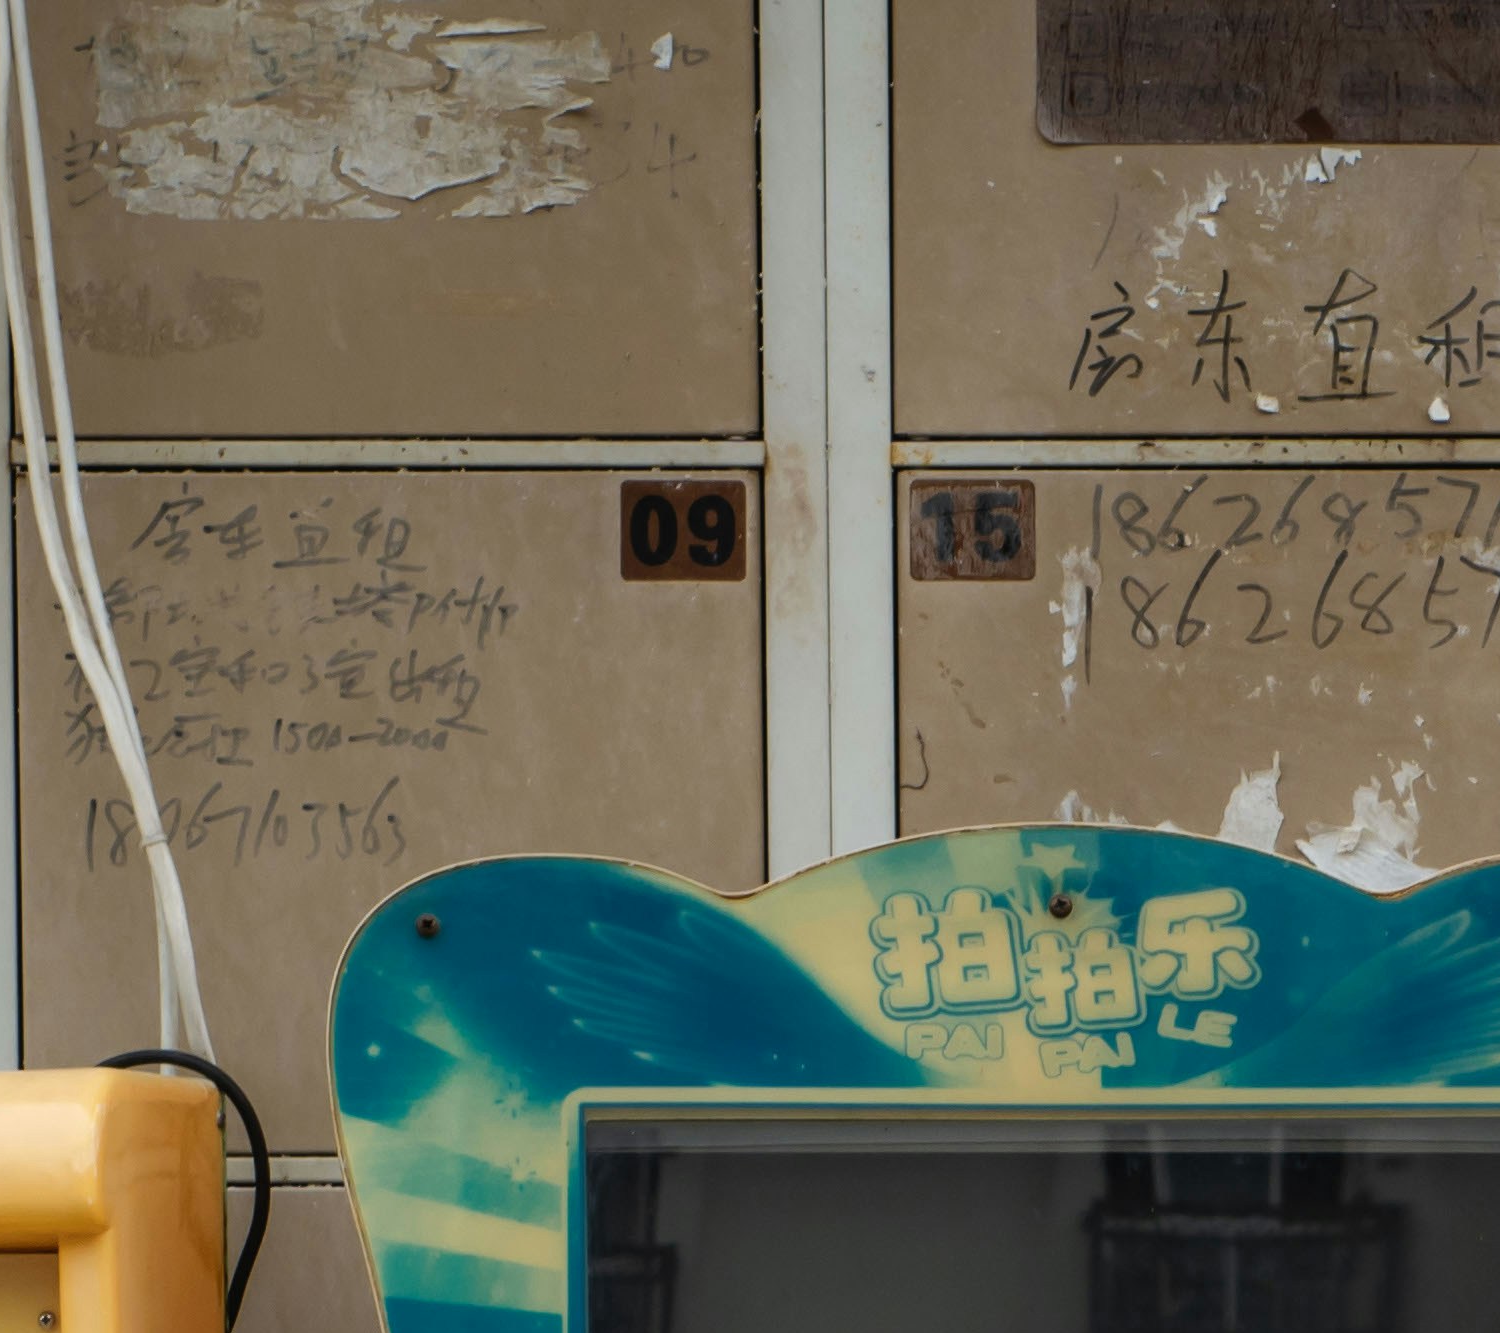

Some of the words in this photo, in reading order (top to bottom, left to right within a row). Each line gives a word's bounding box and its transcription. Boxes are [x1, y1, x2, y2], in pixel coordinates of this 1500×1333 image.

[630, 494, 736, 567] 09
[918, 491, 1025, 564] 15
[869, 886, 1262, 1037] 拍拍乐
[903, 1023, 1004, 1061] PAI
[1038, 1032, 1137, 1078] PAI
[1157, 1003, 1238, 1048] LE
